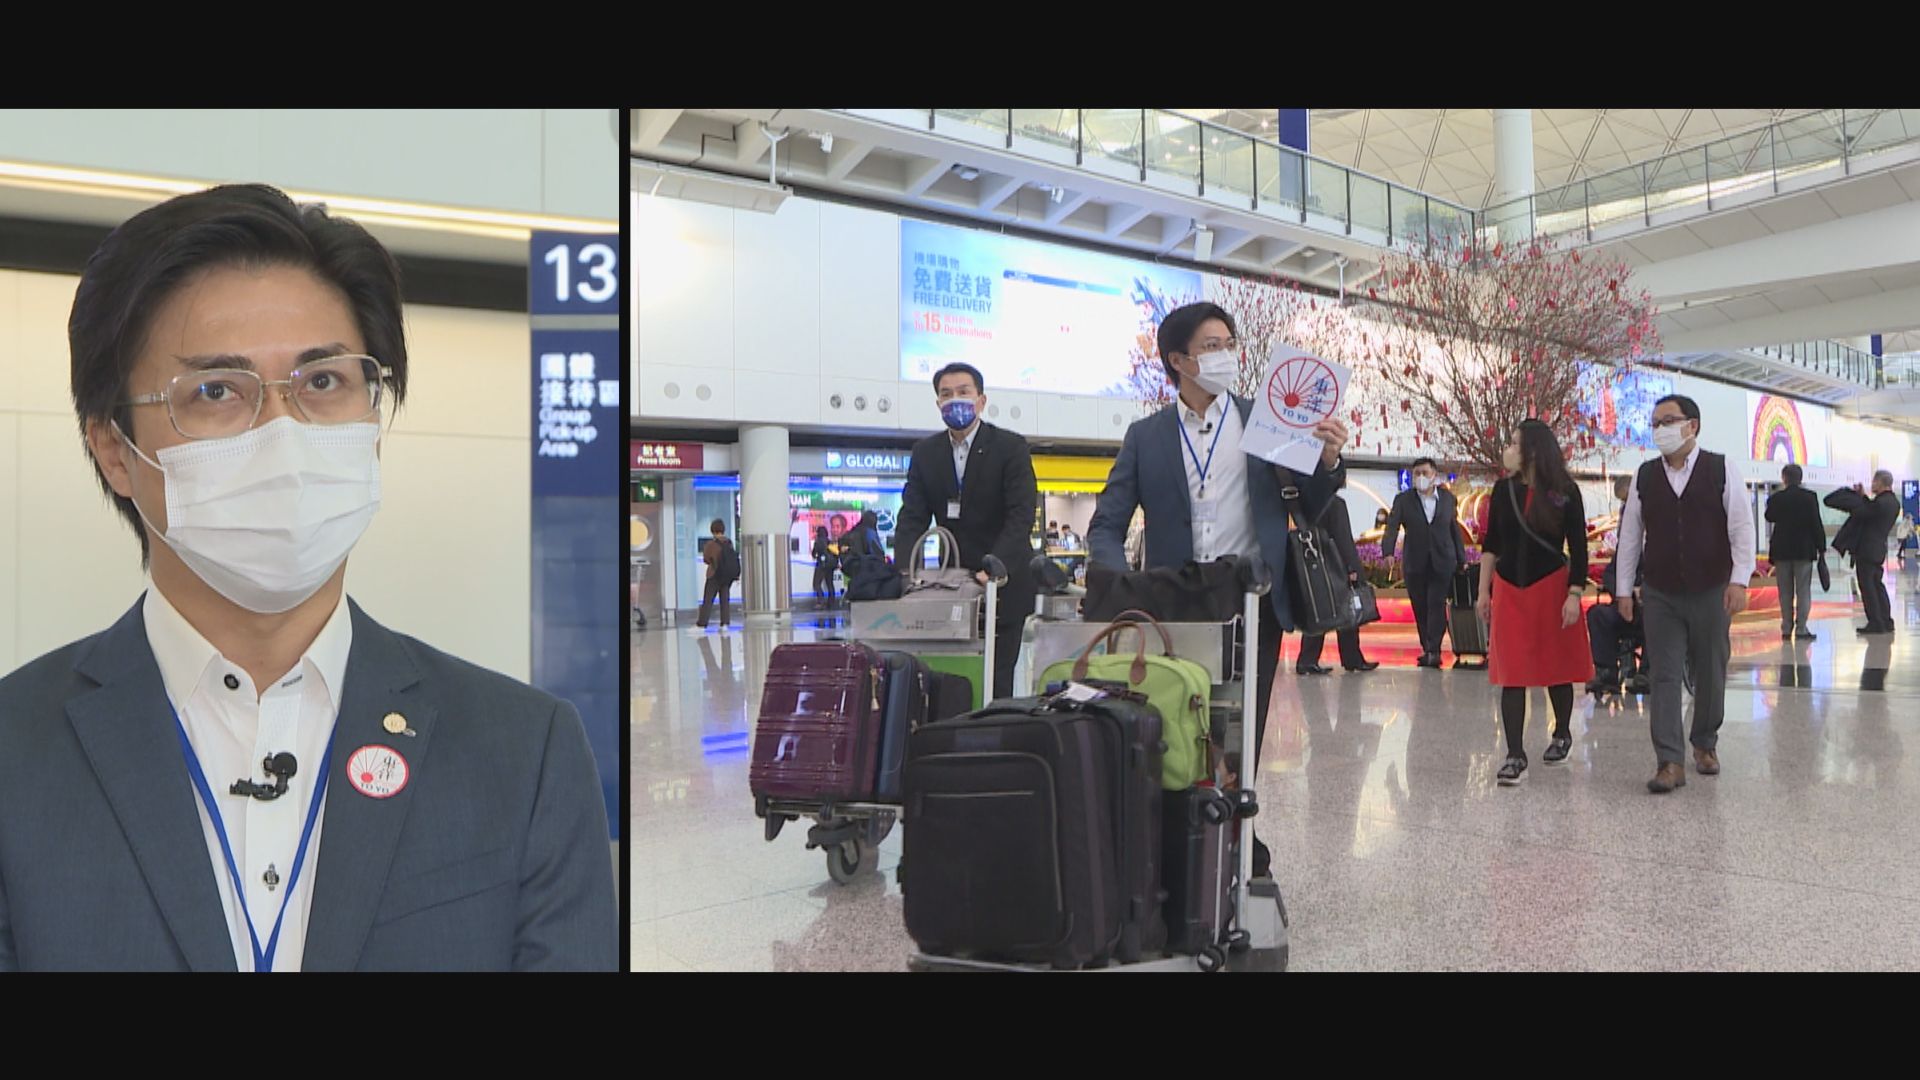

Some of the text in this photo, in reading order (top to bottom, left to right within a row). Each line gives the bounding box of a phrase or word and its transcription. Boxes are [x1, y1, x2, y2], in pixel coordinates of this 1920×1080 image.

[545, 243, 617, 302] 13
[913, 266, 992, 299] 免費送貨
[913, 290, 992, 314] FREE DELIVERY
[923, 311, 941, 333] 15
[539, 407, 591, 425] Group
[539, 423, 598, 444] Pick-up
[538, 440, 579, 457] Area
[637, 455, 681, 466] Press Room
[846, 454, 900, 469] GLOBAL
